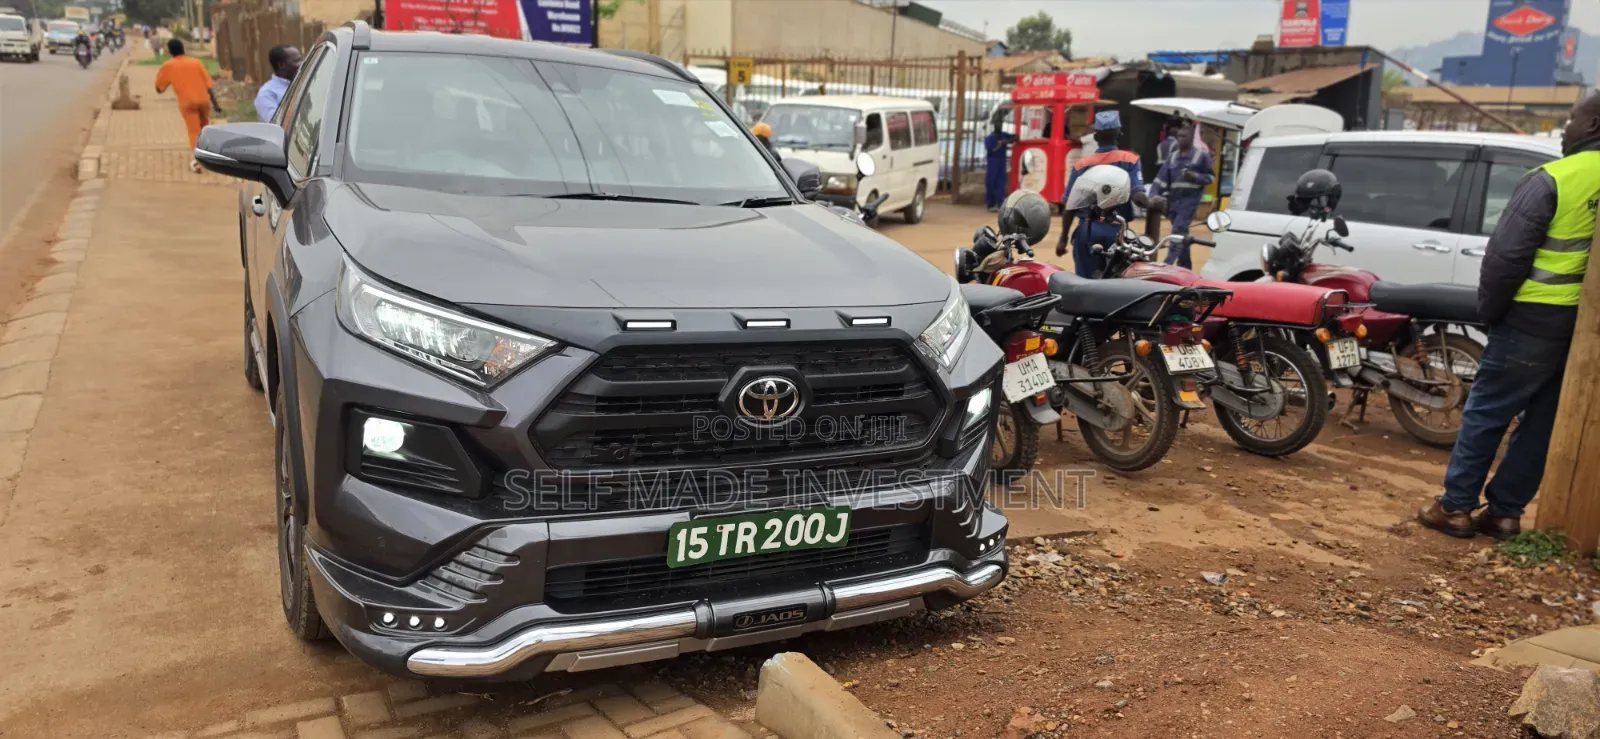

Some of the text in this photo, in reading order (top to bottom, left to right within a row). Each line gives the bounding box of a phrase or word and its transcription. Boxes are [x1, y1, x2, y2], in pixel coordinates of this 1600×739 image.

[1017, 358, 1039, 376] UMA
[676, 527, 708, 562] 15
[754, 608, 805, 625] JAOS
